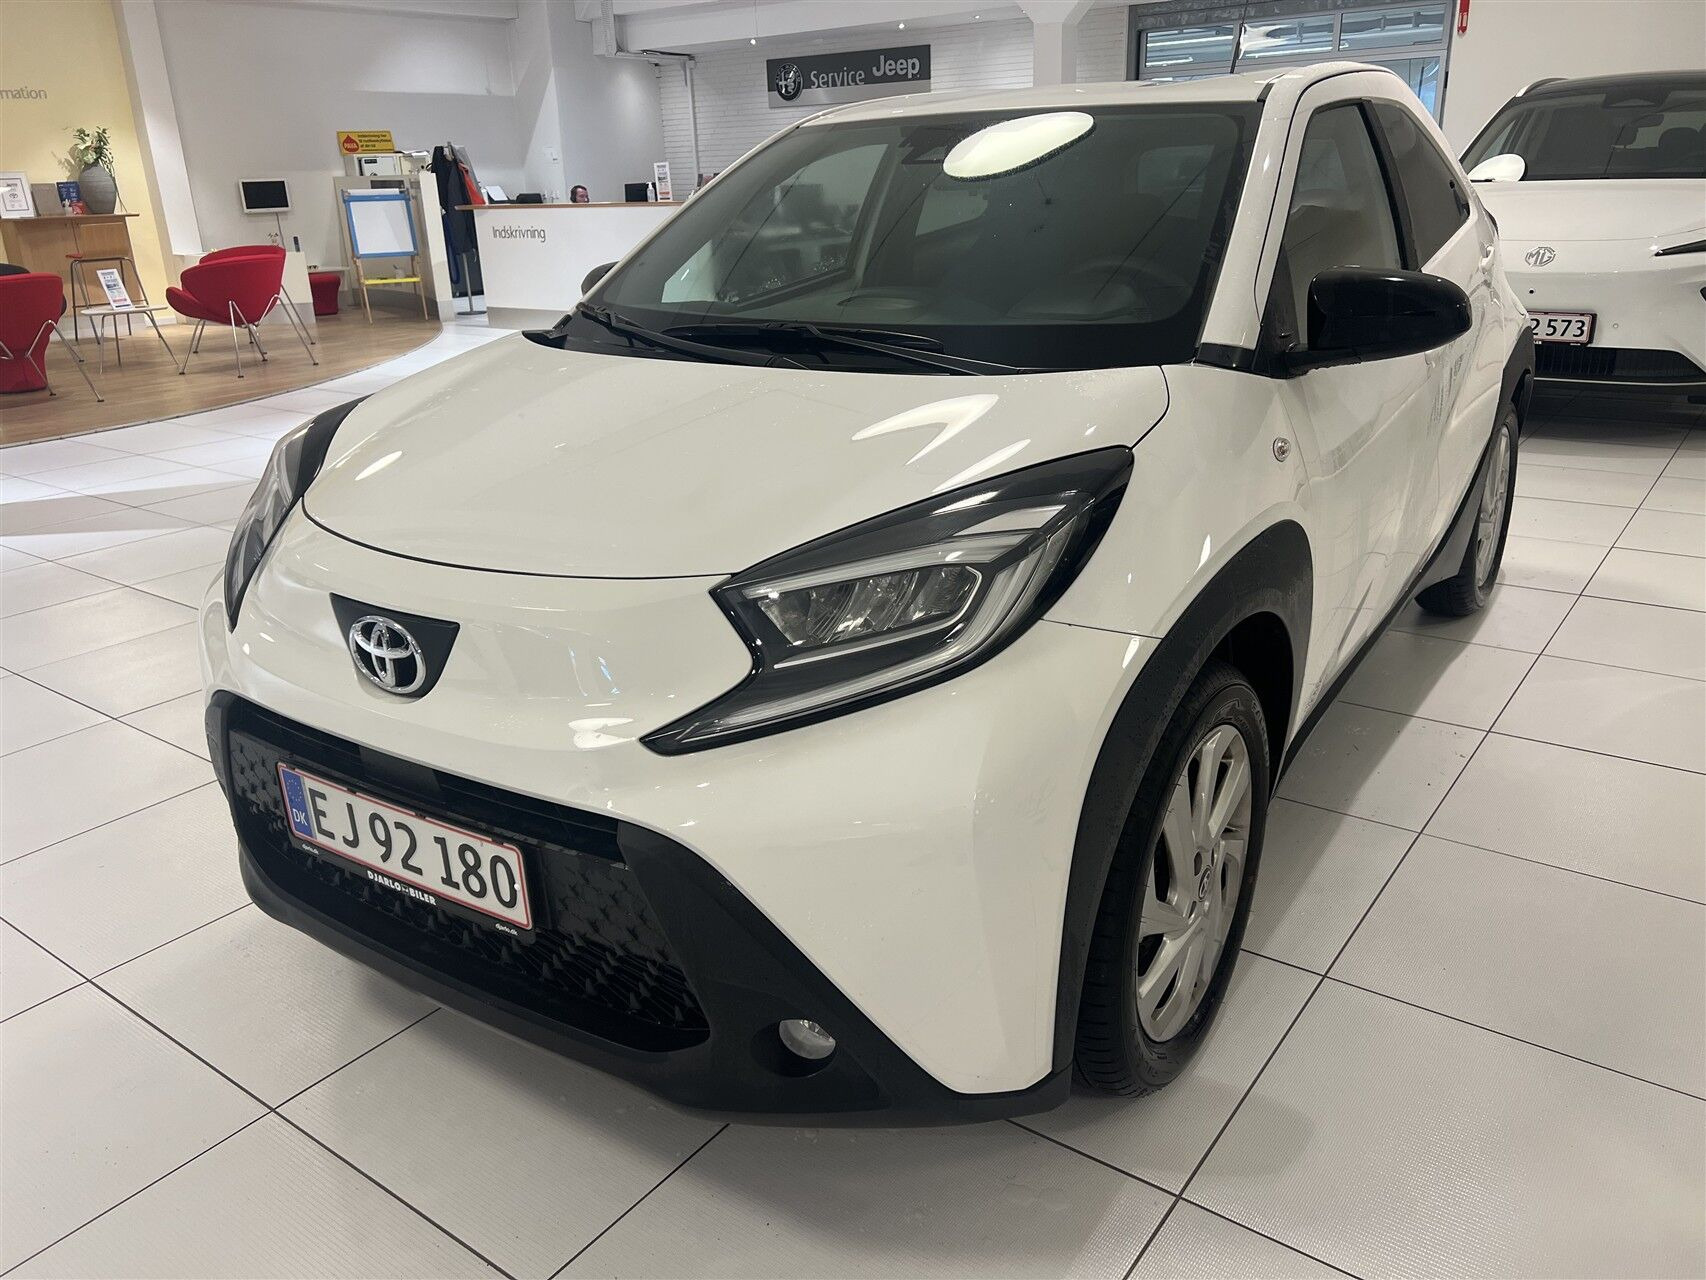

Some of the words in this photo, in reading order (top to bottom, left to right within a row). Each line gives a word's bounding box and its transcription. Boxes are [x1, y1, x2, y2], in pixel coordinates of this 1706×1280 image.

[872, 55, 920, 78] Jeep
[810, 67, 865, 88] Service
[0, 86, 47, 99] mation
[492, 226, 546, 243] Indskrivning
[1526, 247, 1555, 266] MG
[1545, 318, 1586, 337] 573
[292, 808, 308, 826] DK
[308, 787, 360, 848] EJ
[368, 812, 423, 876] 92
[434, 836, 518, 909] 180
[367, 870, 401, 891] DJARLO
[409, 887, 436, 906] BILER
